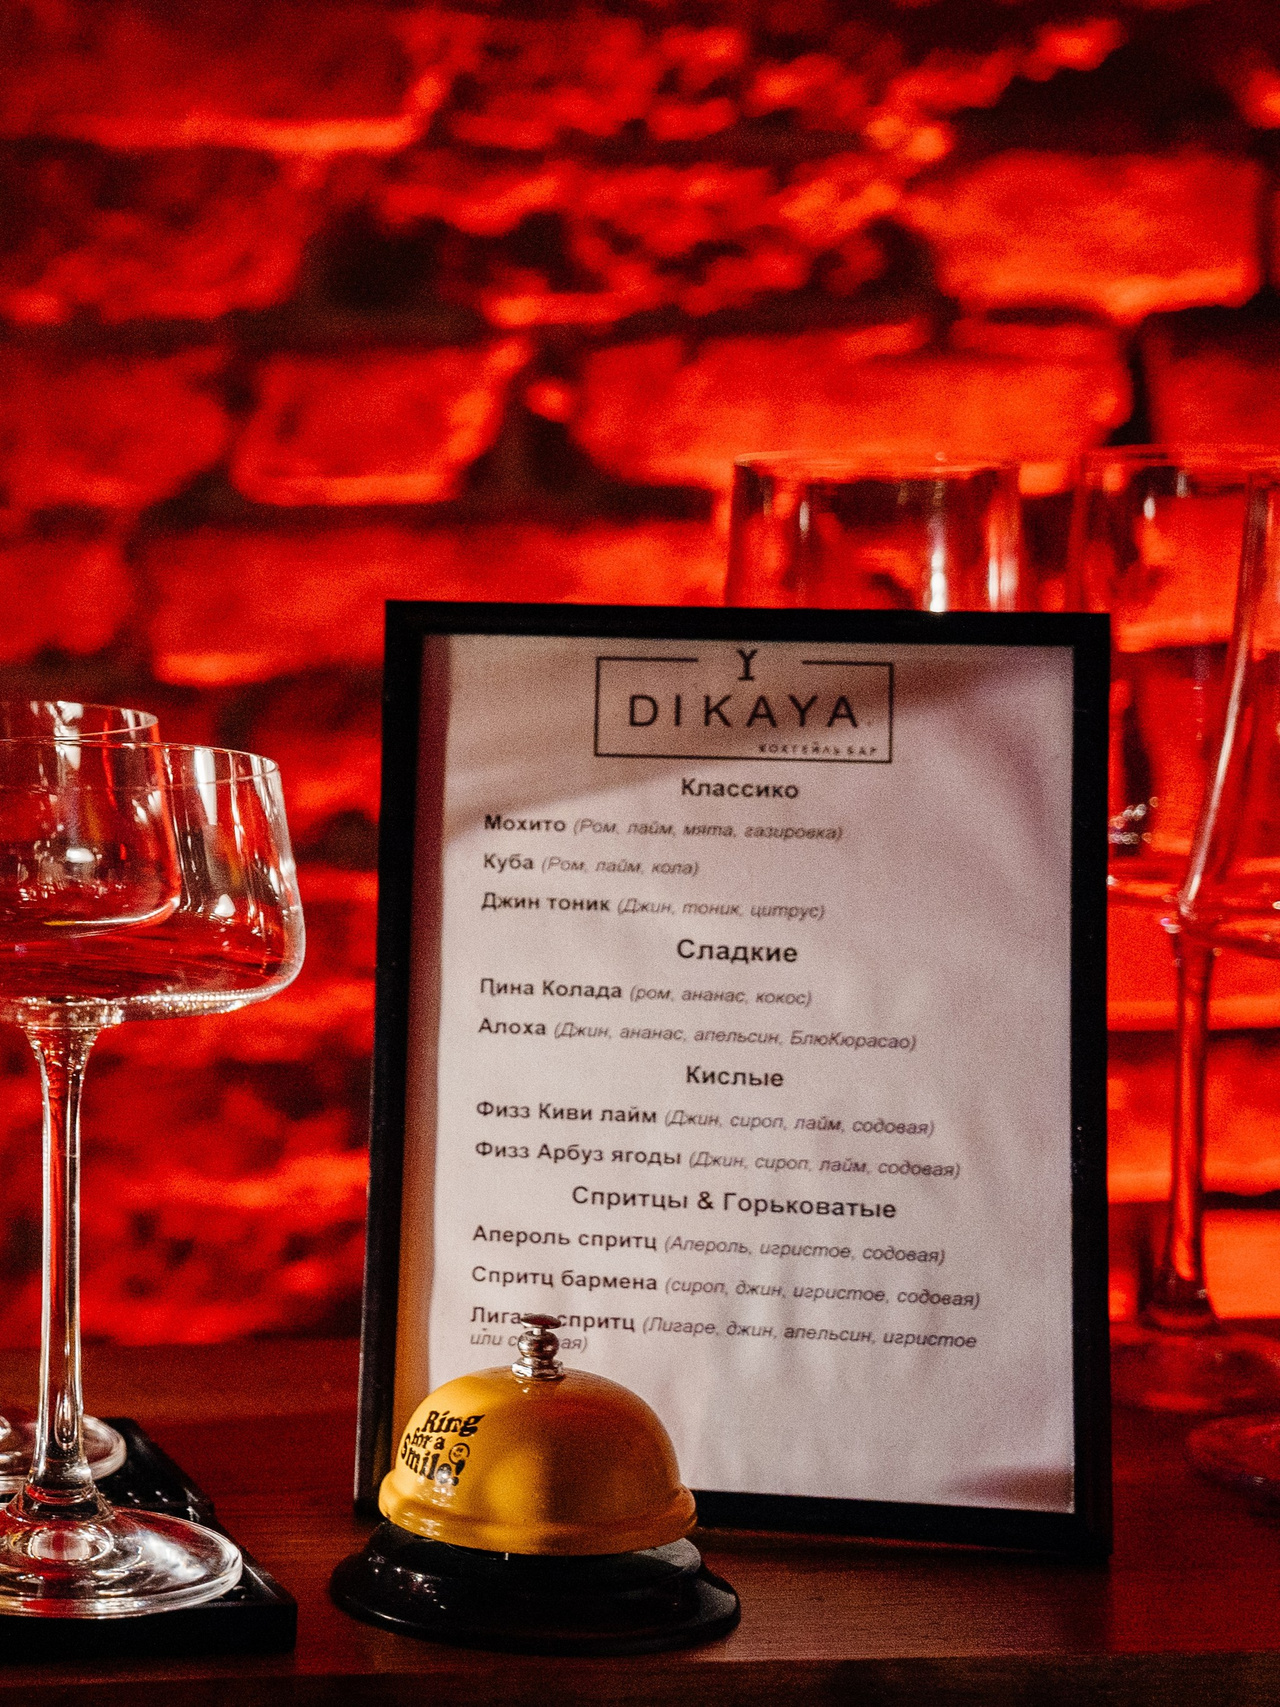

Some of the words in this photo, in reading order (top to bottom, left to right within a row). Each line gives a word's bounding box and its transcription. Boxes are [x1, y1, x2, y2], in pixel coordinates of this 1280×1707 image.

[629, 694, 858, 728] DIKAYA
[681, 778, 800, 799] Классико
[484, 814, 566, 832] Мохито
[573, 818, 619, 836] (Ром,
[627, 820, 676, 837] лайм,
[683, 823, 737, 838] мята,
[744, 824, 842, 841] газировка)
[484, 853, 534, 874] Куба
[541, 856, 589, 872] (Ром,
[596, 858, 645, 874] лайм,
[652, 861, 700, 877] кола)
[481, 892, 540, 912] Джин
[546, 896, 611, 912] тоник
[617, 898, 676, 917] (Джин,
[682, 902, 744, 918] тоник,
[751, 904, 825, 921] цитрус)
[676, 938, 798, 964] Сладкие
[480, 978, 535, 997] Пина
[542, 980, 623, 1001] Колада
[630, 985, 676, 1003] (ром,
[681, 988, 750, 1004] ананас,
[755, 991, 812, 1007] кокос)
[479, 1017, 546, 1037] Алоха
[554, 1021, 614, 1039] (Джин,
[620, 1026, 688, 1042] ананас,
[694, 1028, 784, 1046] апельсин,
[790, 1030, 917, 1052] БлюКюрасао)
[685, 1065, 784, 1088] Кислые
[476, 1100, 531, 1121] Физз
[538, 1103, 593, 1121] Киви
[600, 1105, 657, 1125] лайм
[664, 1109, 723, 1128] (Джин,
[730, 1113, 788, 1130] сироп,
[794, 1115, 846, 1133] лайм,
[852, 1117, 935, 1138] содовая)
[475, 1141, 529, 1160] Физз
[537, 1143, 604, 1165] Арбуз
[611, 1148, 682, 1167] ягоды
[688, 1152, 749, 1170] (Джин,
[755, 1155, 813, 1173] сироп,
[819, 1156, 872, 1175] лайм,
[878, 1160, 961, 1180] содовая)
[571, 1186, 688, 1211] Спритцы
[697, 1191, 715, 1211] &
[723, 1192, 897, 1220] Горьковатые
[472, 1226, 571, 1247] Апероль
[578, 1232, 657, 1252] спритц
[664, 1235, 754, 1257] (Апероль,
[760, 1241, 857, 1262] игристое,
[862, 1244, 946, 1266] содовая)
[471, 1266, 554, 1288] Спритц
[561, 1269, 657, 1292] бармена
[664, 1276, 729, 1297] (сироп,
[734, 1278, 787, 1299] джин,
[792, 1284, 890, 1305] игристое,
[896, 1287, 981, 1310] содовая)
[471, 1333, 502, 1346] или
[557, 1312, 636, 1333] спритц
[642, 1318, 720, 1338] (Лигаре,
[727, 1320, 778, 1340] джин,
[783, 1326, 877, 1344] апельсин,
[882, 1327, 978, 1350] игристое
[411, 1427, 433, 1449] for
[434, 1436, 446, 1450] a
